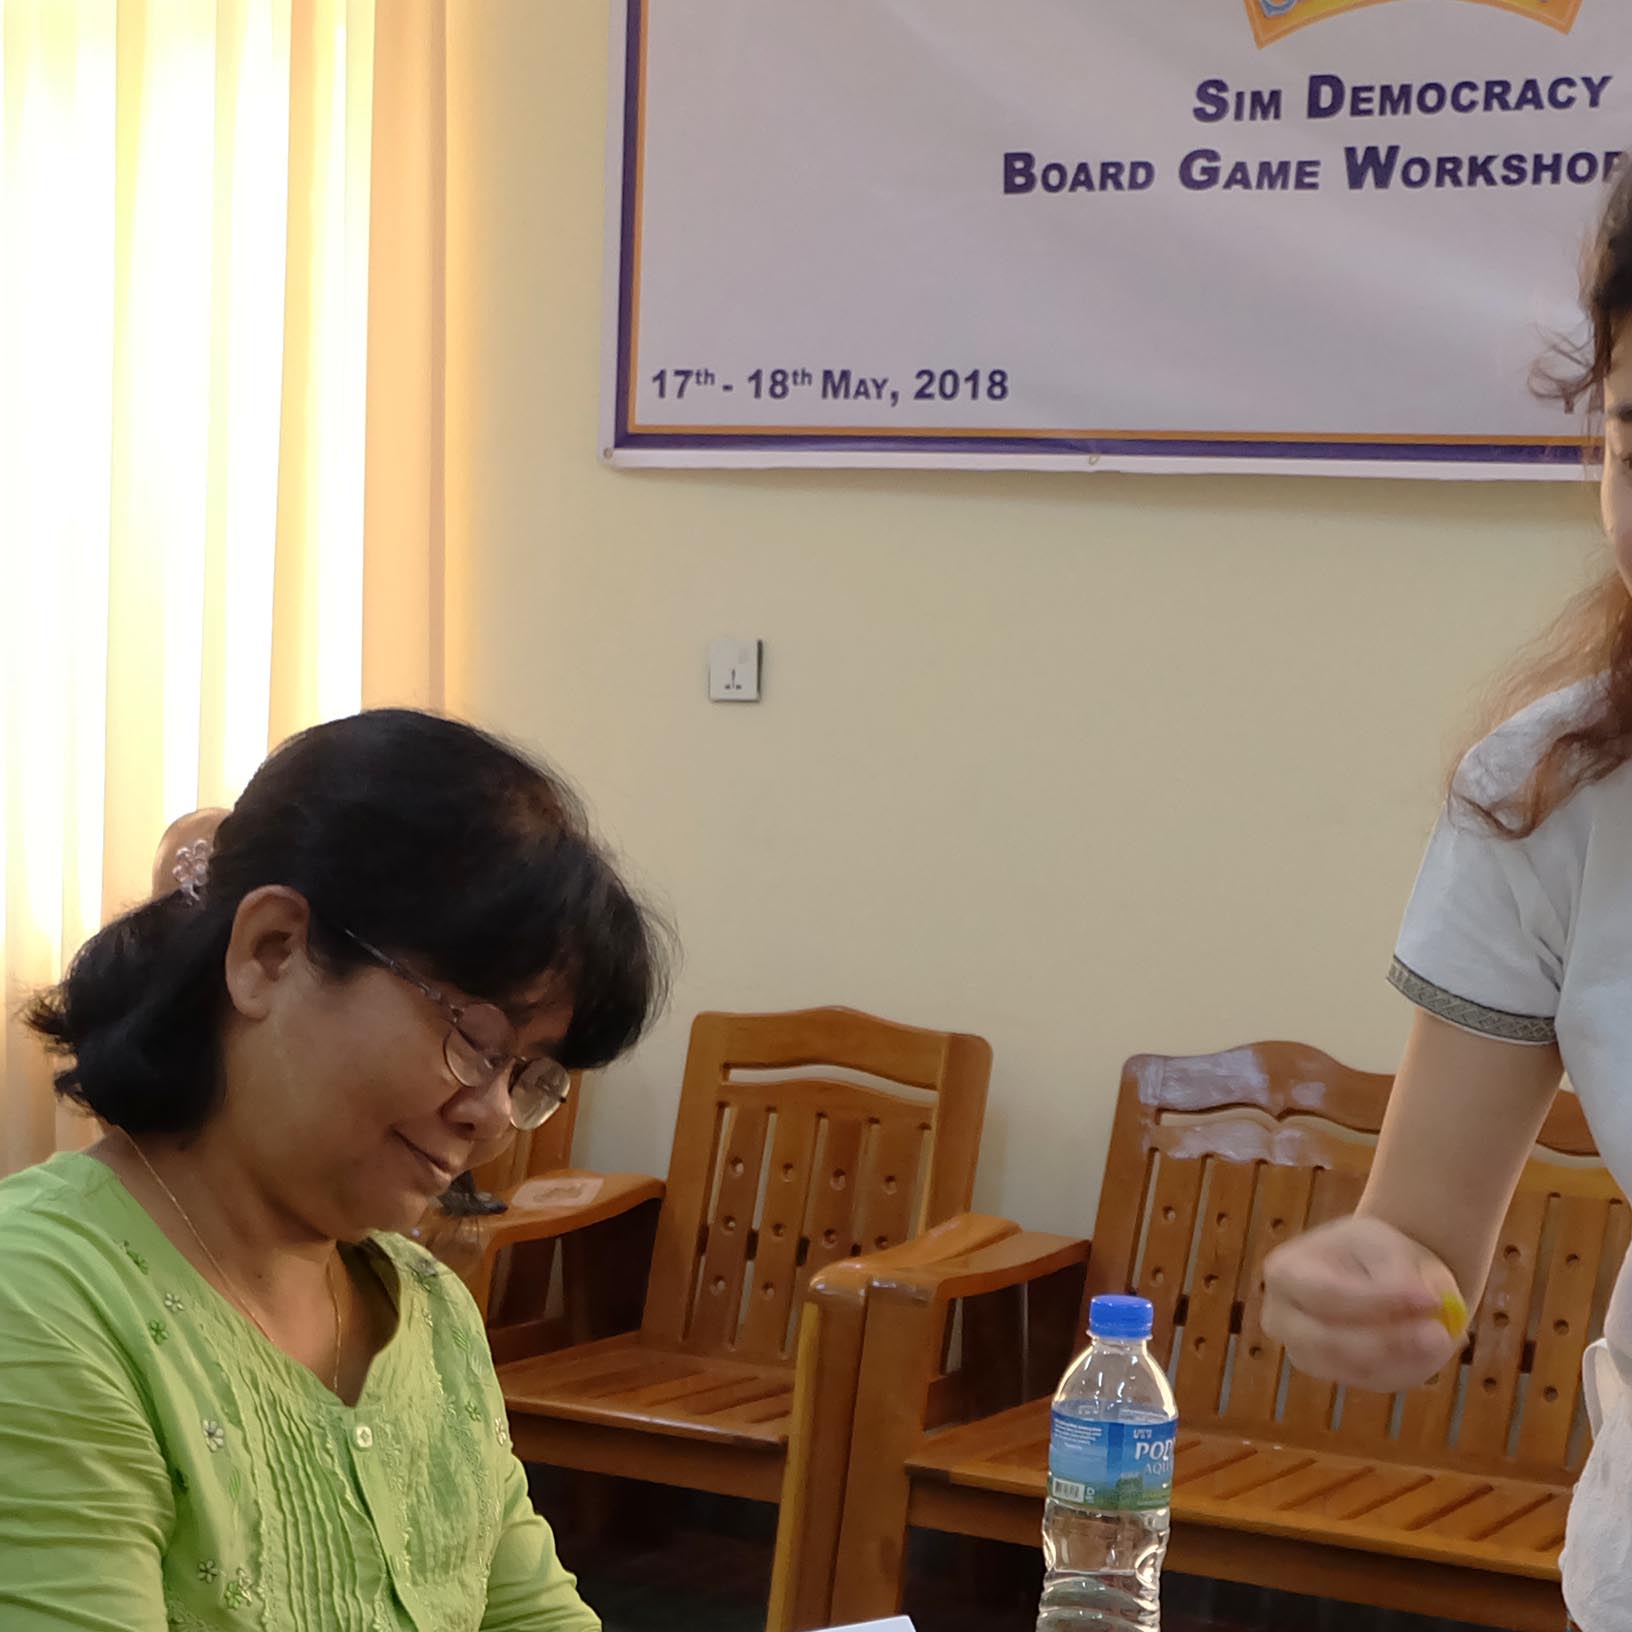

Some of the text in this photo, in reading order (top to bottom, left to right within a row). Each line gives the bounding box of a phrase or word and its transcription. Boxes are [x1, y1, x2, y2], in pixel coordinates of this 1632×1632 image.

[1192, 74, 1613, 123] SIM DEMOCRACY
[1002, 151, 1156, 195] BOARD
[1178, 148, 1322, 191] GAME
[651, 368, 716, 400] 17th
[747, 368, 813, 400] 18th
[913, 369, 1010, 400] 2018
